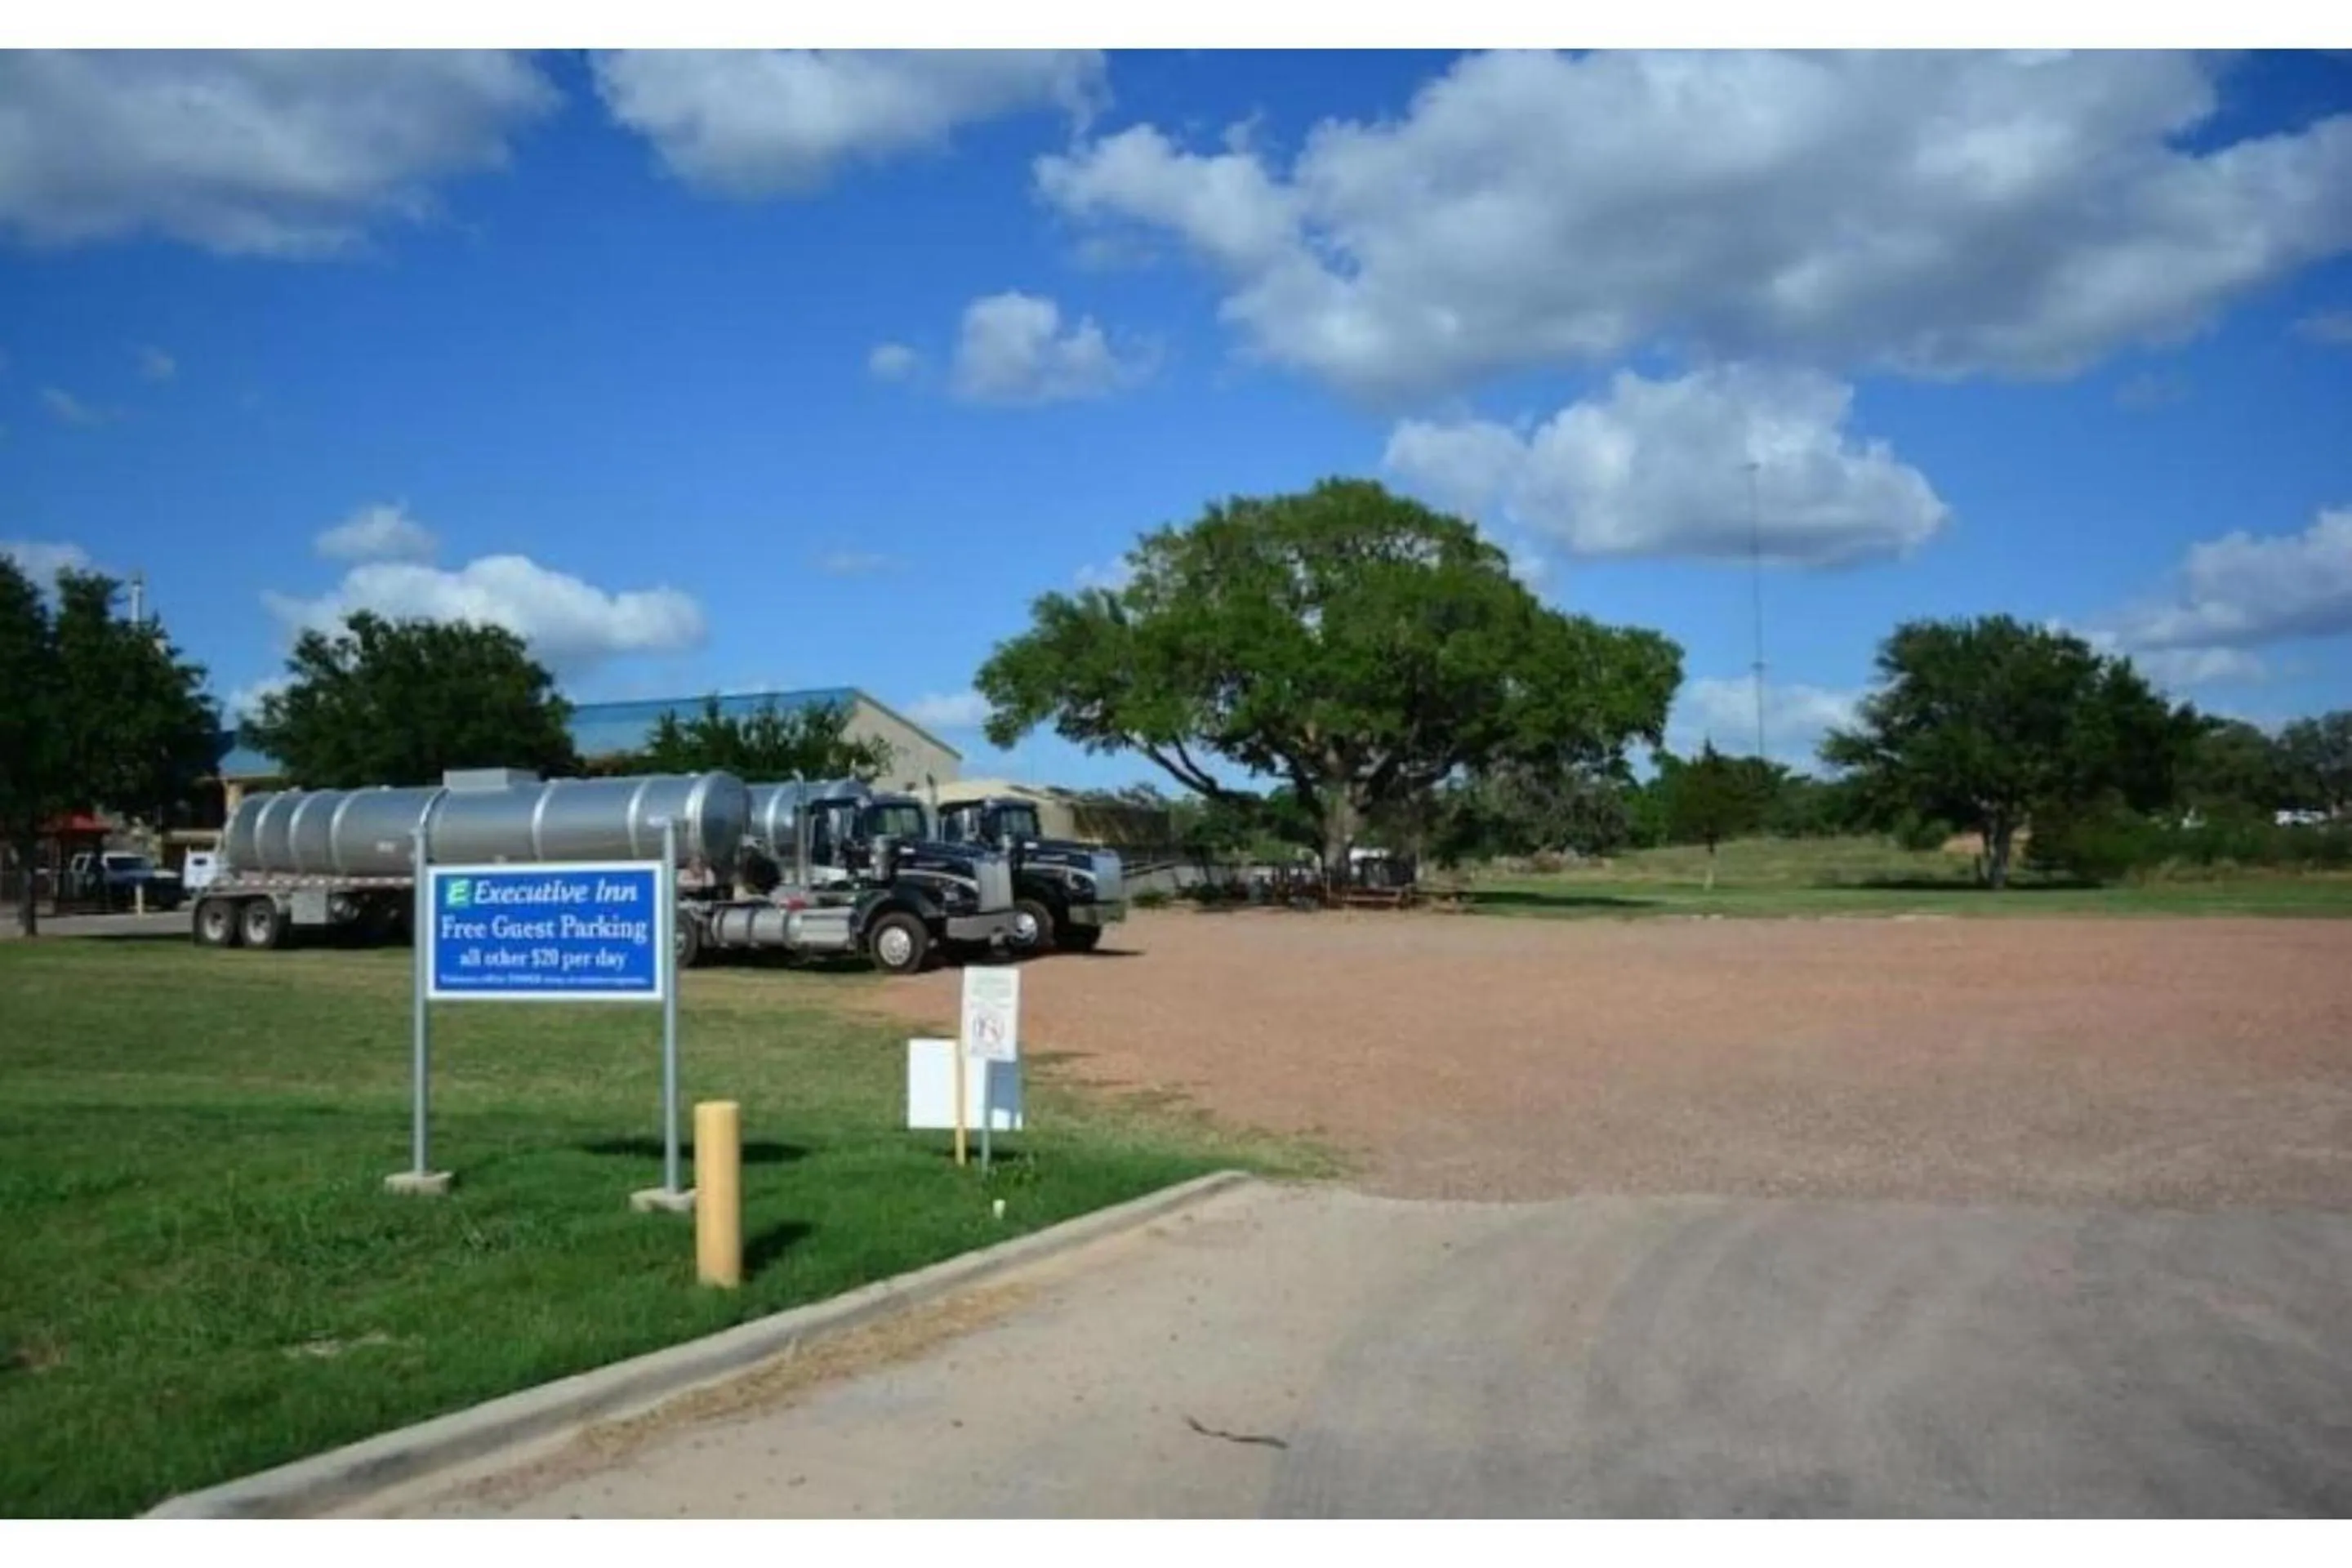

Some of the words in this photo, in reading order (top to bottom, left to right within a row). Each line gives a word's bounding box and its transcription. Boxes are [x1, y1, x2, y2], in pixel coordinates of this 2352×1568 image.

[474, 880, 589, 904] Executive
[595, 878, 638, 903] Inn
[441, 915, 487, 939] Free
[492, 914, 554, 939] Guest
[560, 913, 648, 945] Parking
[460, 948, 481, 967] all
[483, 947, 528, 967] other
[532, 947, 559, 969] $20
[562, 952, 591, 972] per
[595, 947, 628, 971] day
